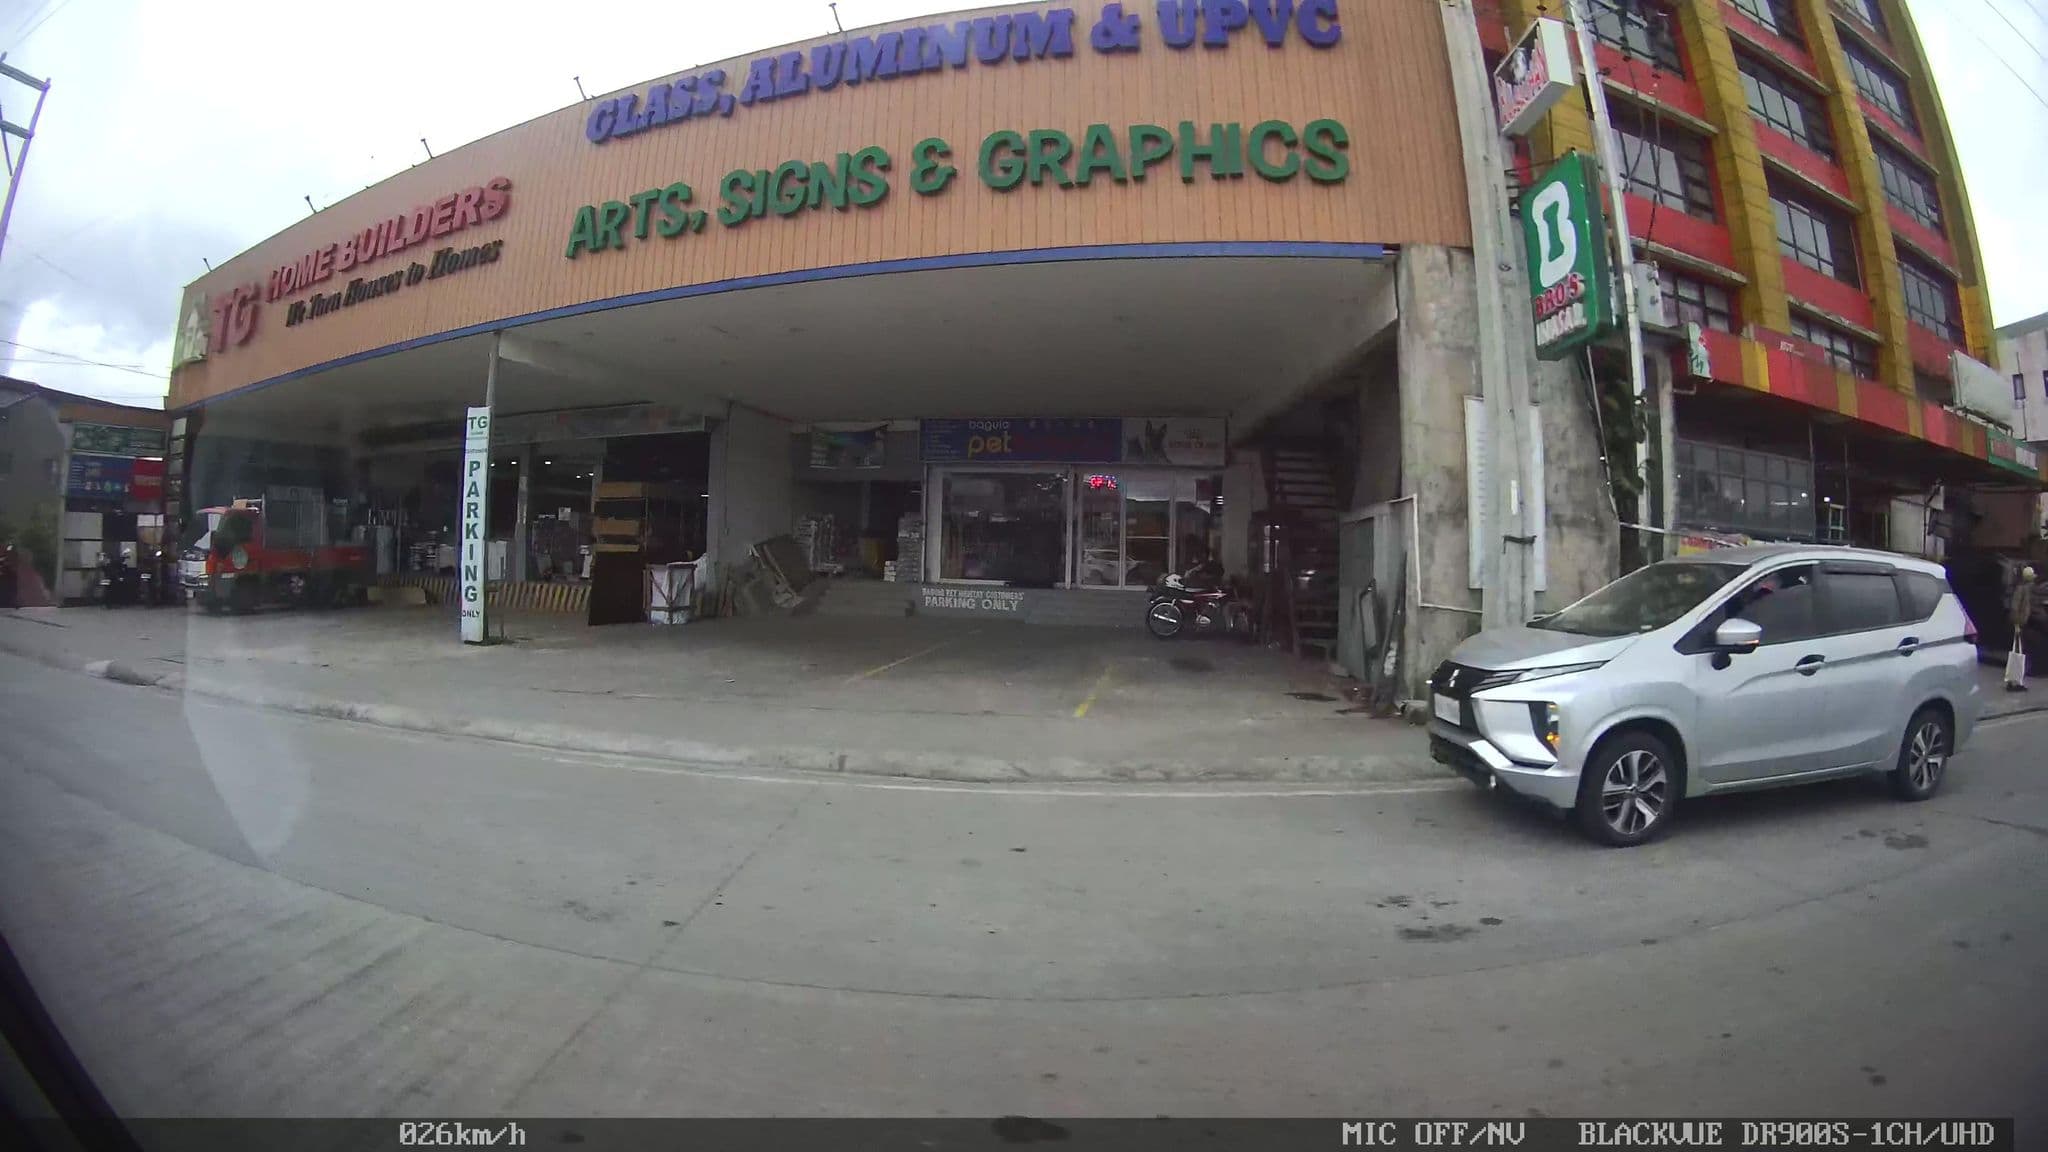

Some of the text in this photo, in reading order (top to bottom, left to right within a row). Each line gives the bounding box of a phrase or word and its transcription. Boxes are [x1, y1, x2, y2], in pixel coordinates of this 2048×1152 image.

[740, 8, 1075, 106] ALUMINUM
[1090, 3, 1142, 54] &
[1156, 0, 1342, 49] UPVC
[565, 118, 1351, 259] ARTS, SIGNS & GRAPHICS
[213, 176, 513, 354] TG HOME BUILDERS
[405, 262, 425, 287] to
[427, 239, 504, 280] Homes
[468, 416, 488, 429] TG
[463, 460, 481, 602] PARKING
[925, 596, 1019, 611] PARKING ONLY
